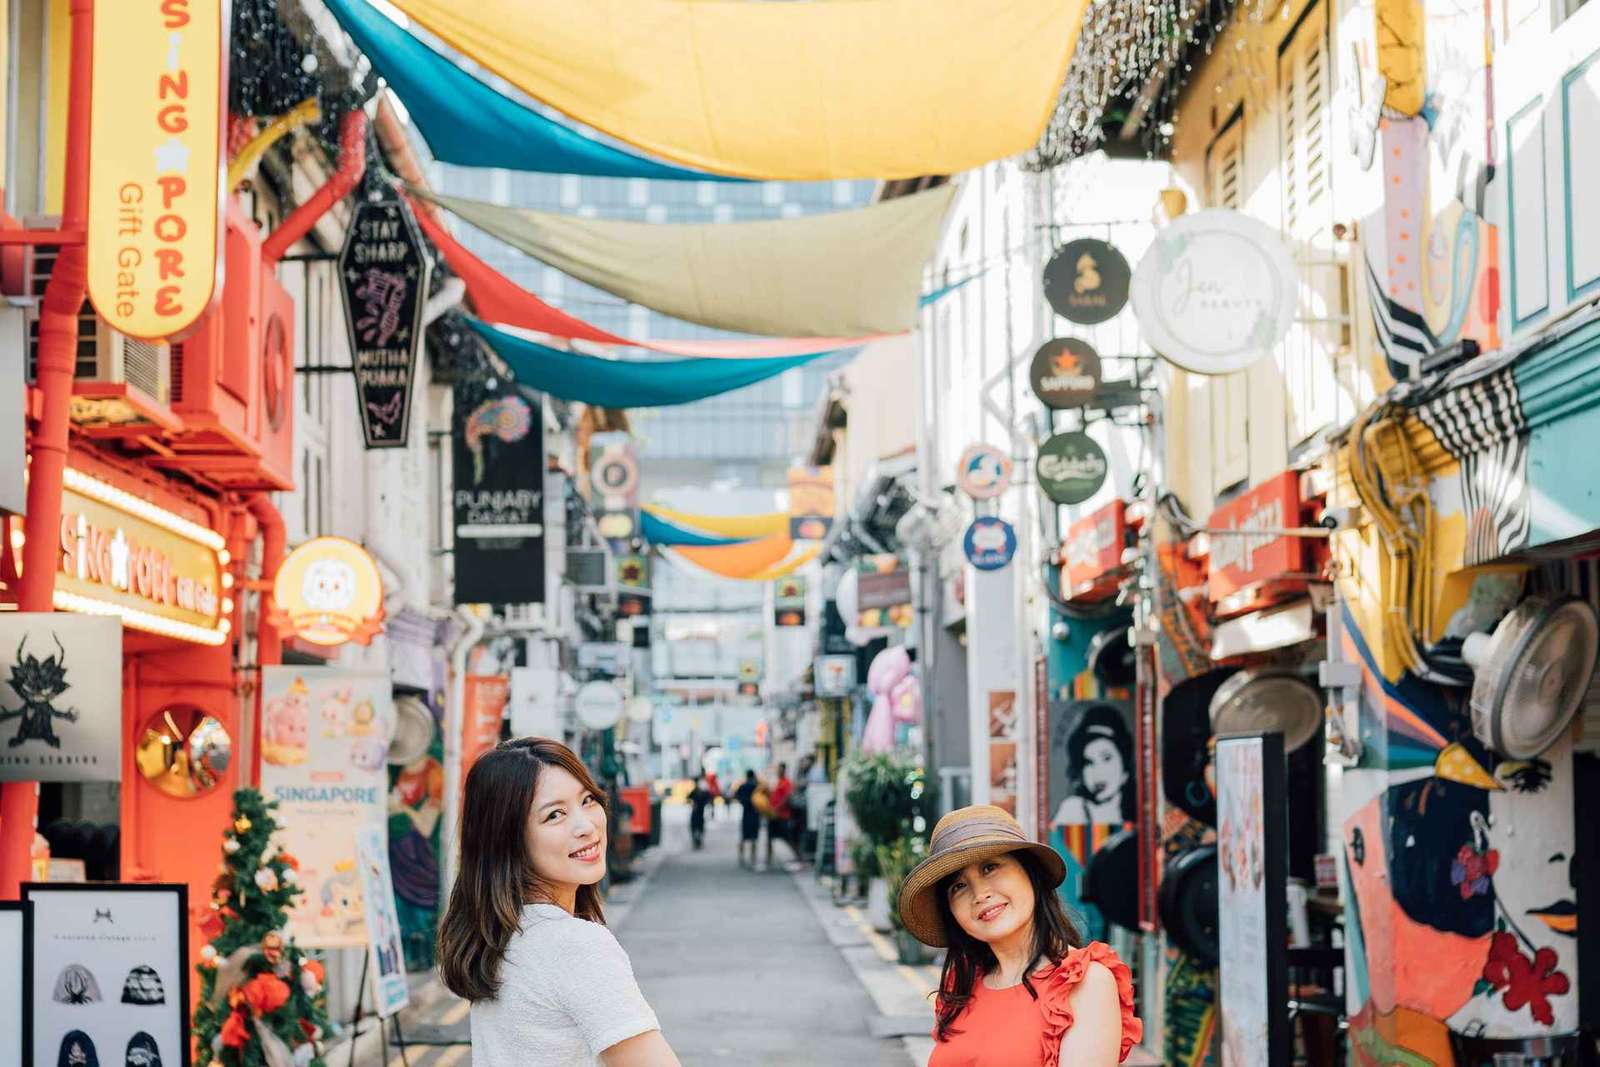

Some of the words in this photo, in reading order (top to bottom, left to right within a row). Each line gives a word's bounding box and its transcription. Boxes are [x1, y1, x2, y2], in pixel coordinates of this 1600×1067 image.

[117, 182, 144, 238] Gift
[360, 220, 400, 240] STAY
[353, 241, 409, 264] SHARP
[115, 247, 142, 319] Gate
[274, 785, 377, 804] SINGAPORE
